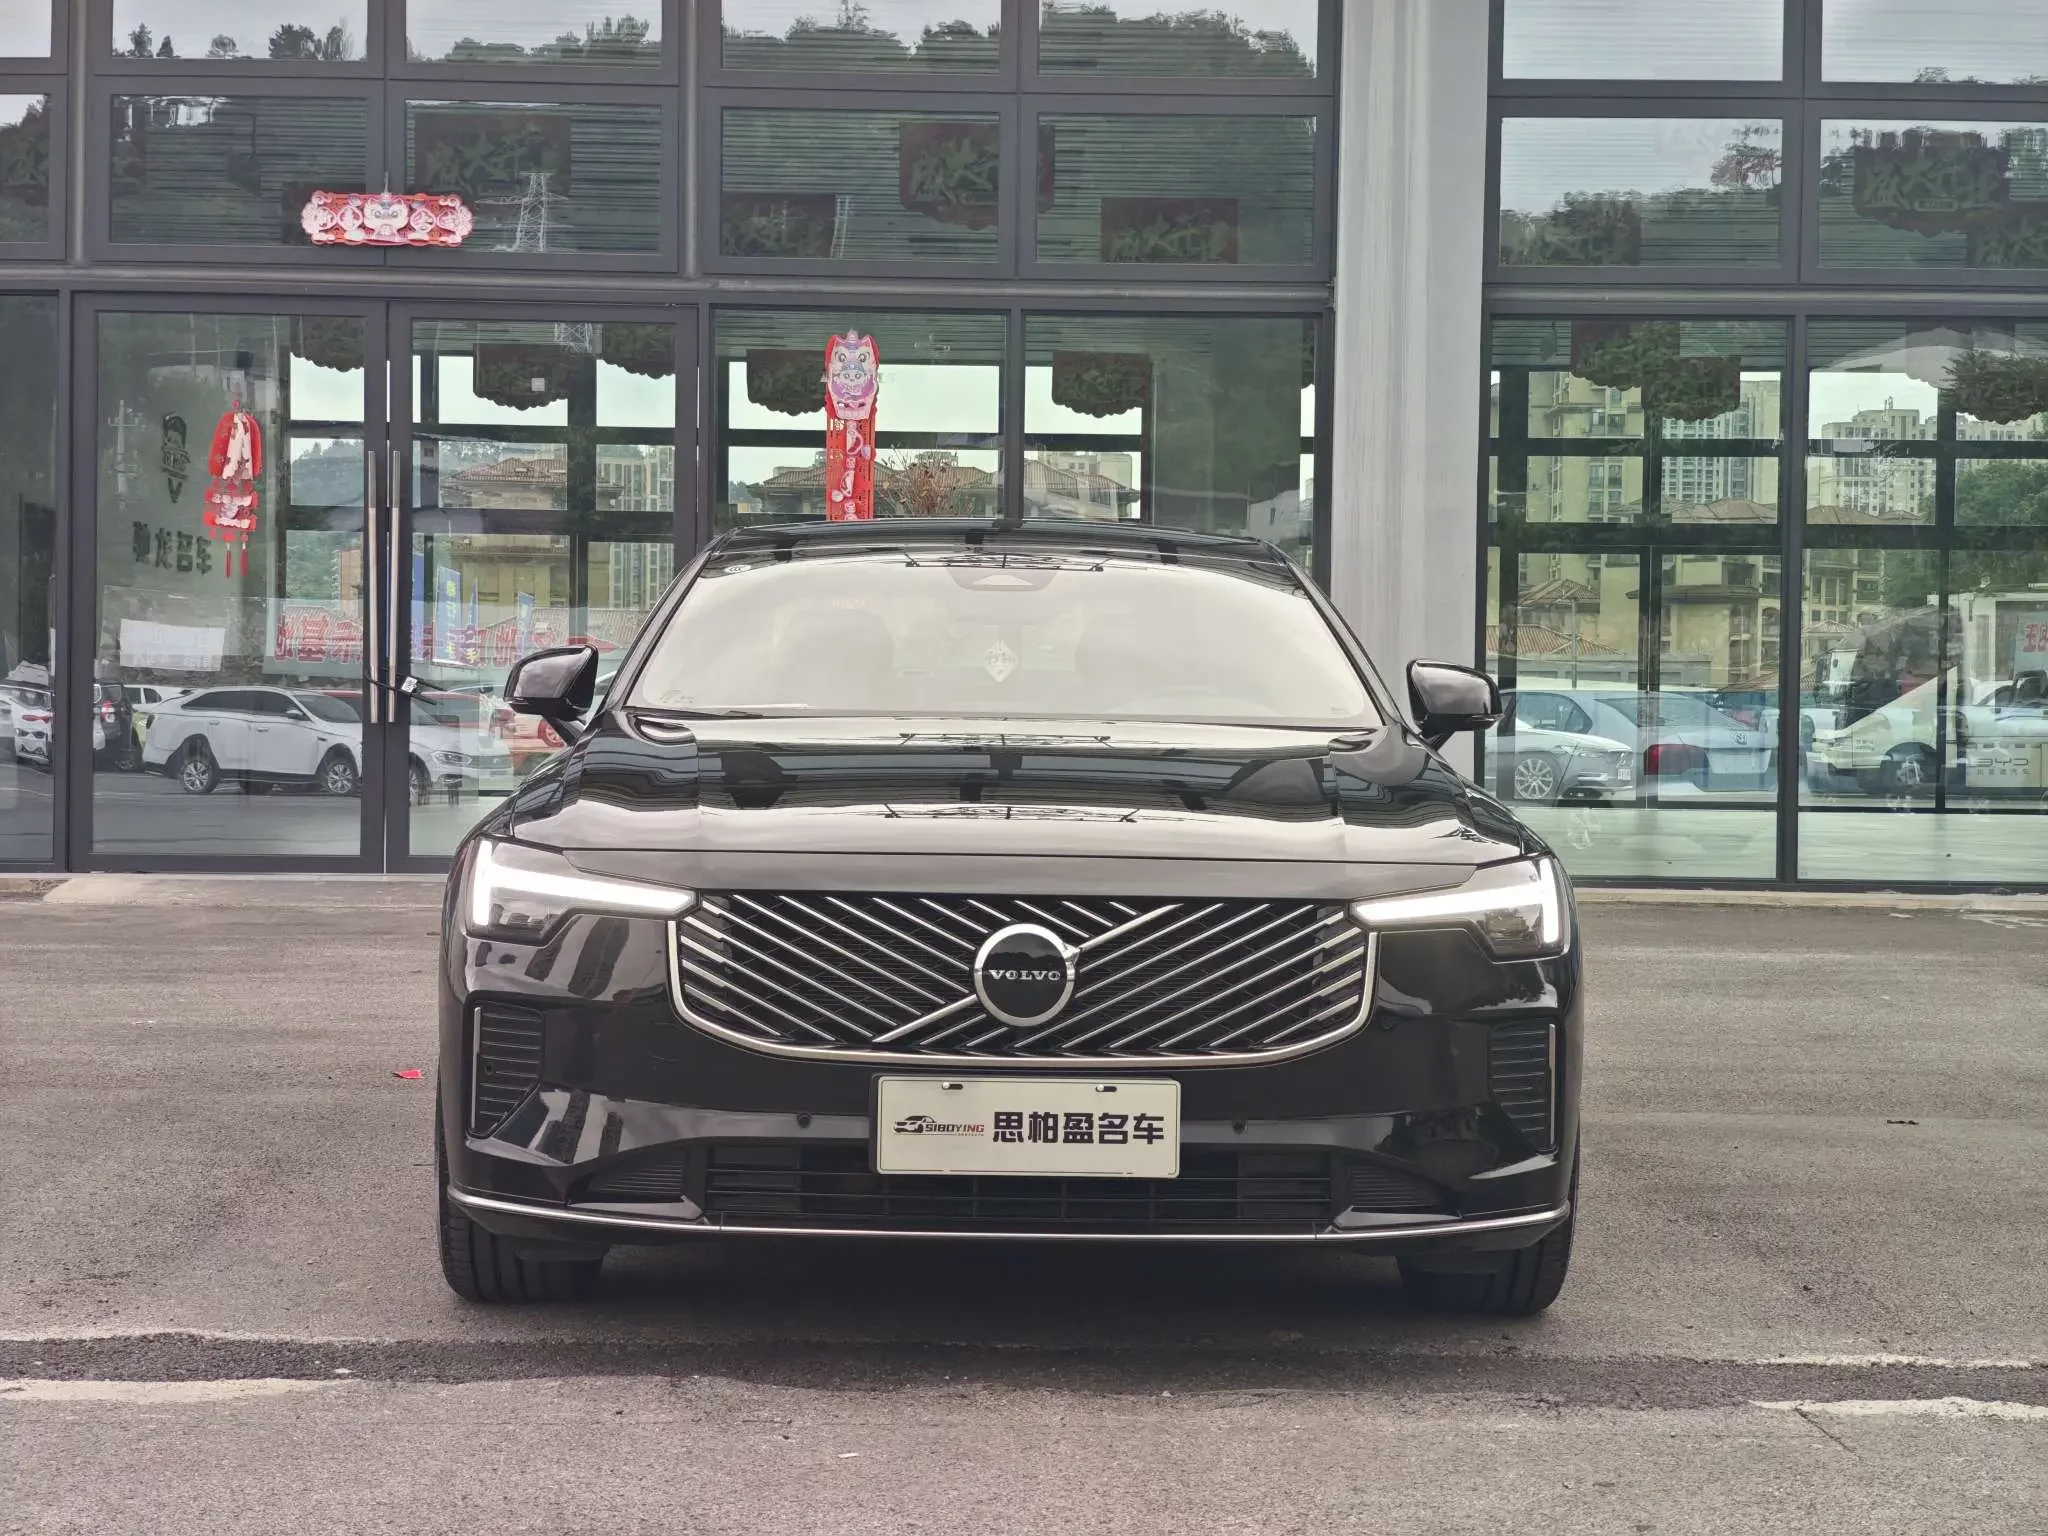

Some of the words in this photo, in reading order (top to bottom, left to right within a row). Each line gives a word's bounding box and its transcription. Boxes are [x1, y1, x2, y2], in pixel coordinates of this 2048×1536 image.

[989, 969, 1061, 981] VOLVO
[925, 1123, 985, 1133] SIBOYING
[992, 1111, 1165, 1144] 思柏盈名车
